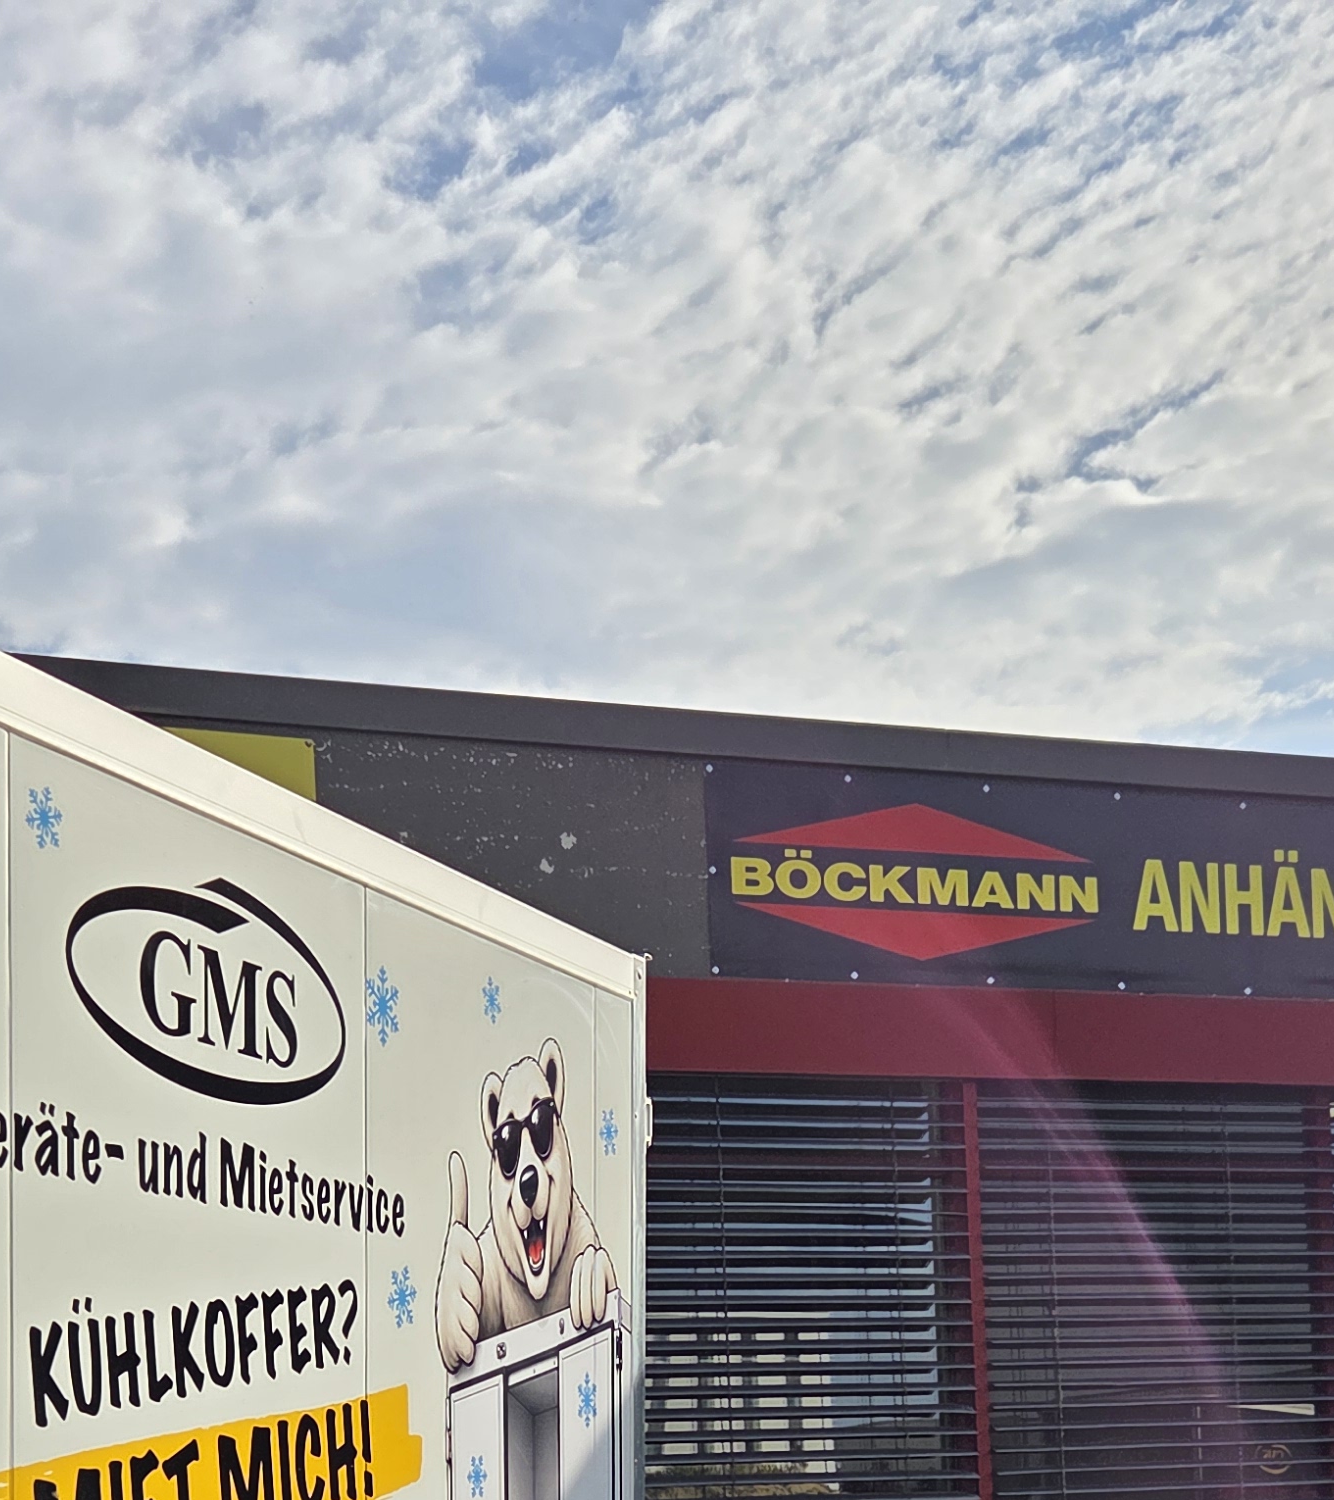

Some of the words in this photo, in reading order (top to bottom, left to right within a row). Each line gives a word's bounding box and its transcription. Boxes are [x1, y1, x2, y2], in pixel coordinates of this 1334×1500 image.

[730, 848, 1099, 914] BÖCKMANN
[139, 929, 299, 1068] GMS
[137, 1131, 208, 1206] und
[219, 1136, 406, 1238] Mietservice
[28, 1279, 359, 1427] KÜHLKOFFER?
